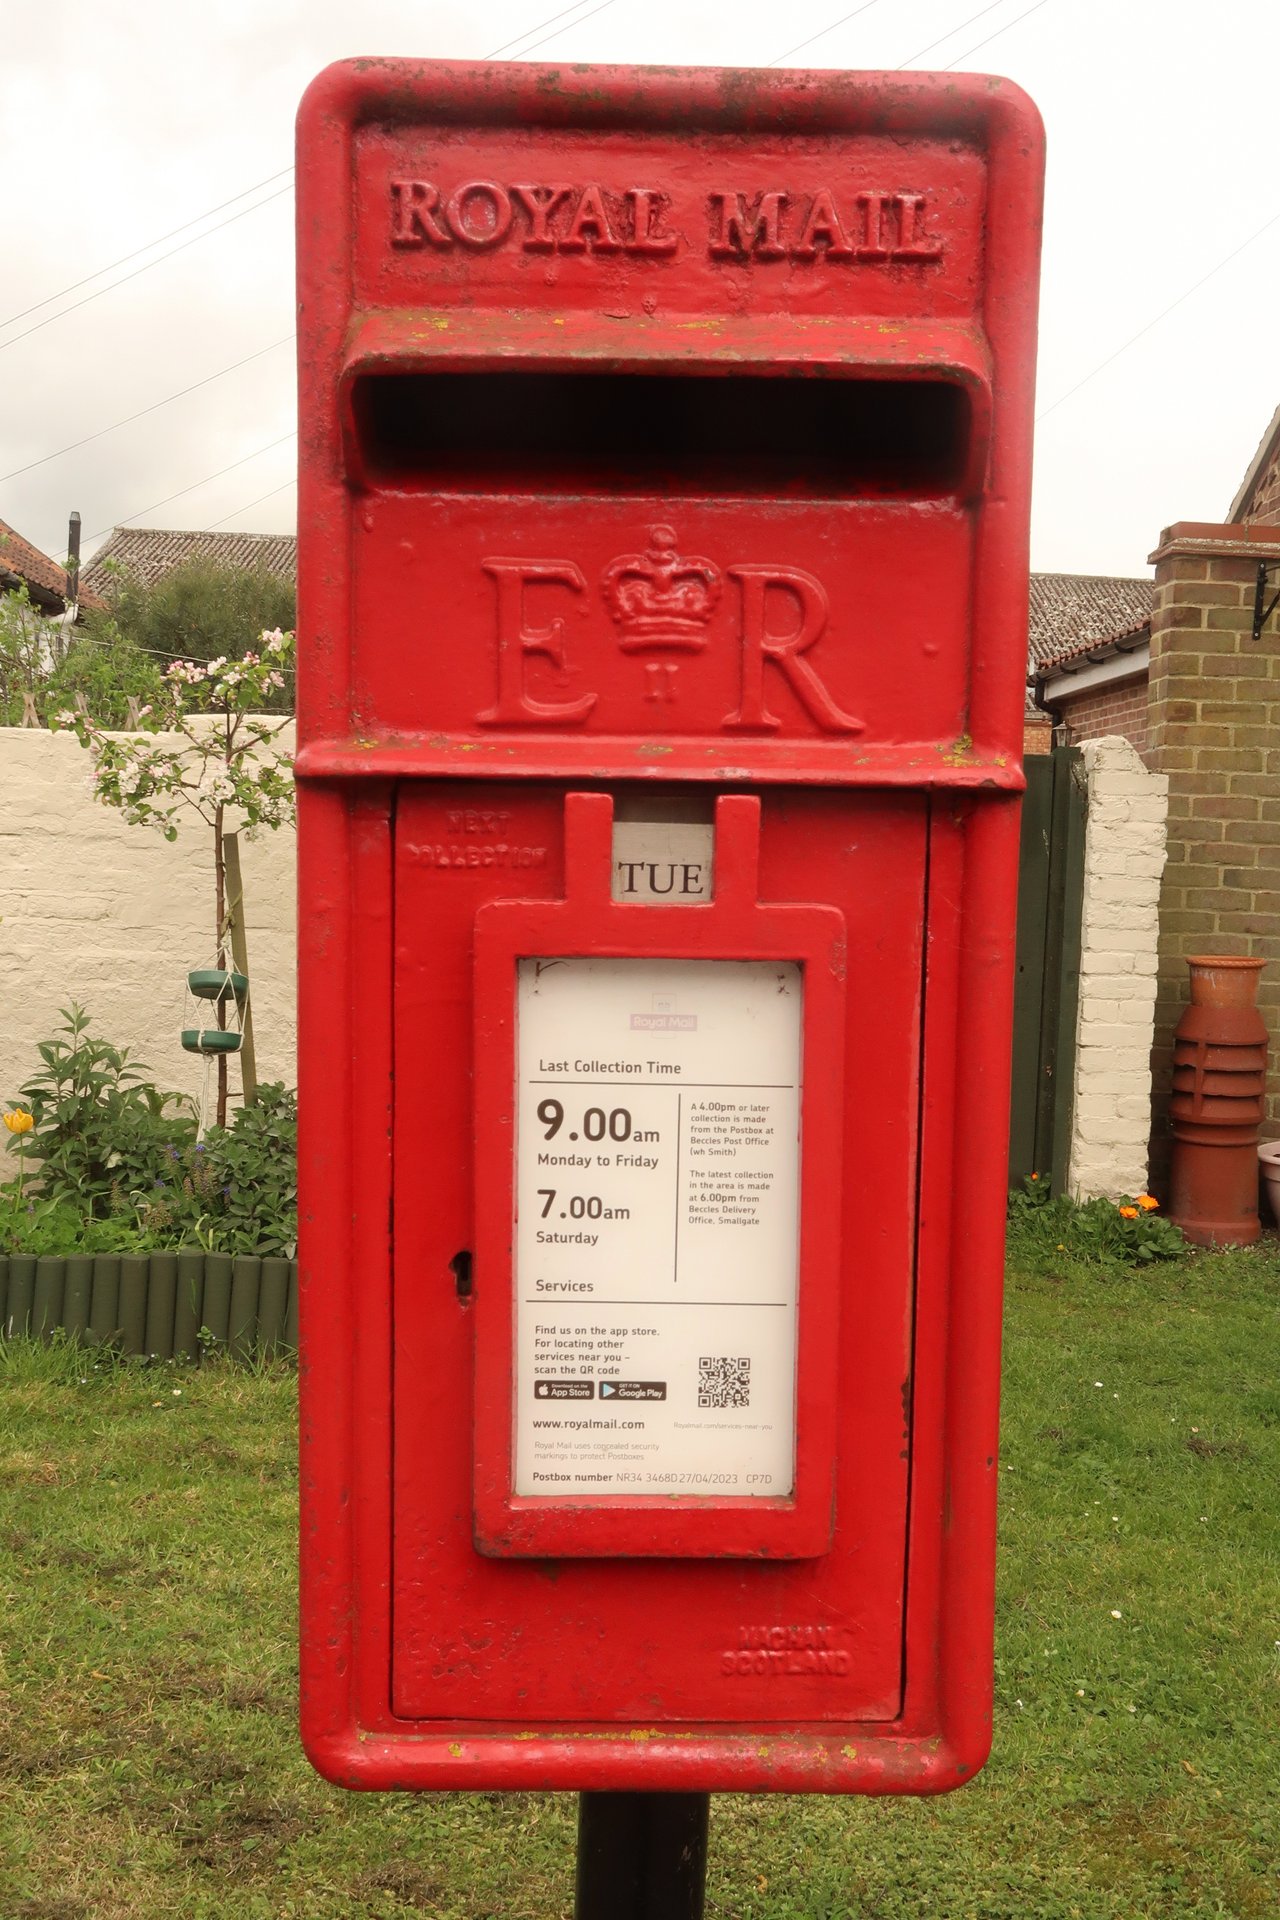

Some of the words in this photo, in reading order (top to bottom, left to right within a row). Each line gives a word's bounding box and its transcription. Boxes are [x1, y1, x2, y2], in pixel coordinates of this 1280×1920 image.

[391, 179, 679, 256] ROYAL
[708, 187, 944, 262] MAIL
[474, 556, 599, 729] E
[721, 562, 867, 734] R
[404, 843, 548, 869] COLLECTION
[618, 861, 704, 894] TUE
[633, 1017, 667, 1028] Royal
[668, 1017, 695, 1028] Mail
[540, 1059, 569, 1072] Last
[574, 1060, 642, 1073] Collection
[646, 1061, 681, 1074] Time
[691, 1103, 697, 1111] A
[699, 1102, 736, 1113] 4.00pm
[738, 1103, 748, 1113] or
[690, 1114, 731, 1124] collection
[734, 1116, 741, 1124] is
[744, 1115, 766, 1124] made
[691, 1125, 711, 1133] from
[730, 1126, 763, 1135] Postbox
[690, 1136, 722, 1146] Beccles
[724, 1136, 743, 1146] Post
[744, 1136, 769, 1147] Office
[708, 1148, 736, 1156] Smith)
[538, 1153, 592, 1169] Monday
[597, 1156, 610, 1166] to
[616, 1154, 659, 1170] Friday
[691, 1170, 705, 1178] The
[708, 1170, 731, 1180] latest
[734, 1171, 774, 1181] collection
[689, 1181, 697, 1191] in
[700, 1182, 714, 1191] the
[716, 1182, 735, 1191] area
[737, 1182, 745, 1191] is
[747, 1182, 771, 1191] made
[700, 1193, 737, 1204] 6.00pm
[689, 1204, 719, 1215] Beccles
[722, 1206, 756, 1215] Delivery
[718, 1217, 760, 1226] Smallgate
[536, 1231, 599, 1246] Saturday
[536, 1279, 594, 1292] Services
[535, 1325, 557, 1334] Find
[591, 1326, 608, 1336] the
[609, 1329, 628, 1337] app
[632, 1328, 659, 1336] store.
[535, 1339, 551, 1348] For
[554, 1339, 594, 1350] locating
[597, 1340, 624, 1350] other
[535, 1352, 575, 1361] services
[577, 1353, 601, 1362] near
[604, 1355, 621, 1363] you
[560, 1365, 576, 1375] the
[579, 1365, 595, 1376] QR
[597, 1366, 620, 1375] code
[551, 1389, 569, 1398] App
[569, 1389, 591, 1397] Store
[618, 1389, 646, 1399] Google
[647, 1389, 663, 1399] Play
[533, 1419, 645, 1431] www.royalmail.com
[535, 1441, 556, 1451] Royal
[557, 1441, 572, 1451] Mail
[574, 1442, 592, 1451] uses
[592, 1441, 630, 1452] concealed
[631, 1443, 660, 1451] security
[534, 1452, 569, 1461] markings
[570, 1452, 579, 1461] to
[580, 1452, 607, 1462] protect
[608, 1452, 644, 1462] Postboxes
[533, 1472, 571, 1481] Postbox
[575, 1473, 613, 1482] number
[617, 1472, 642, 1482] NR34
[745, 1473, 772, 1485] CP7D
[721, 1650, 854, 1677] SCOTLAND
